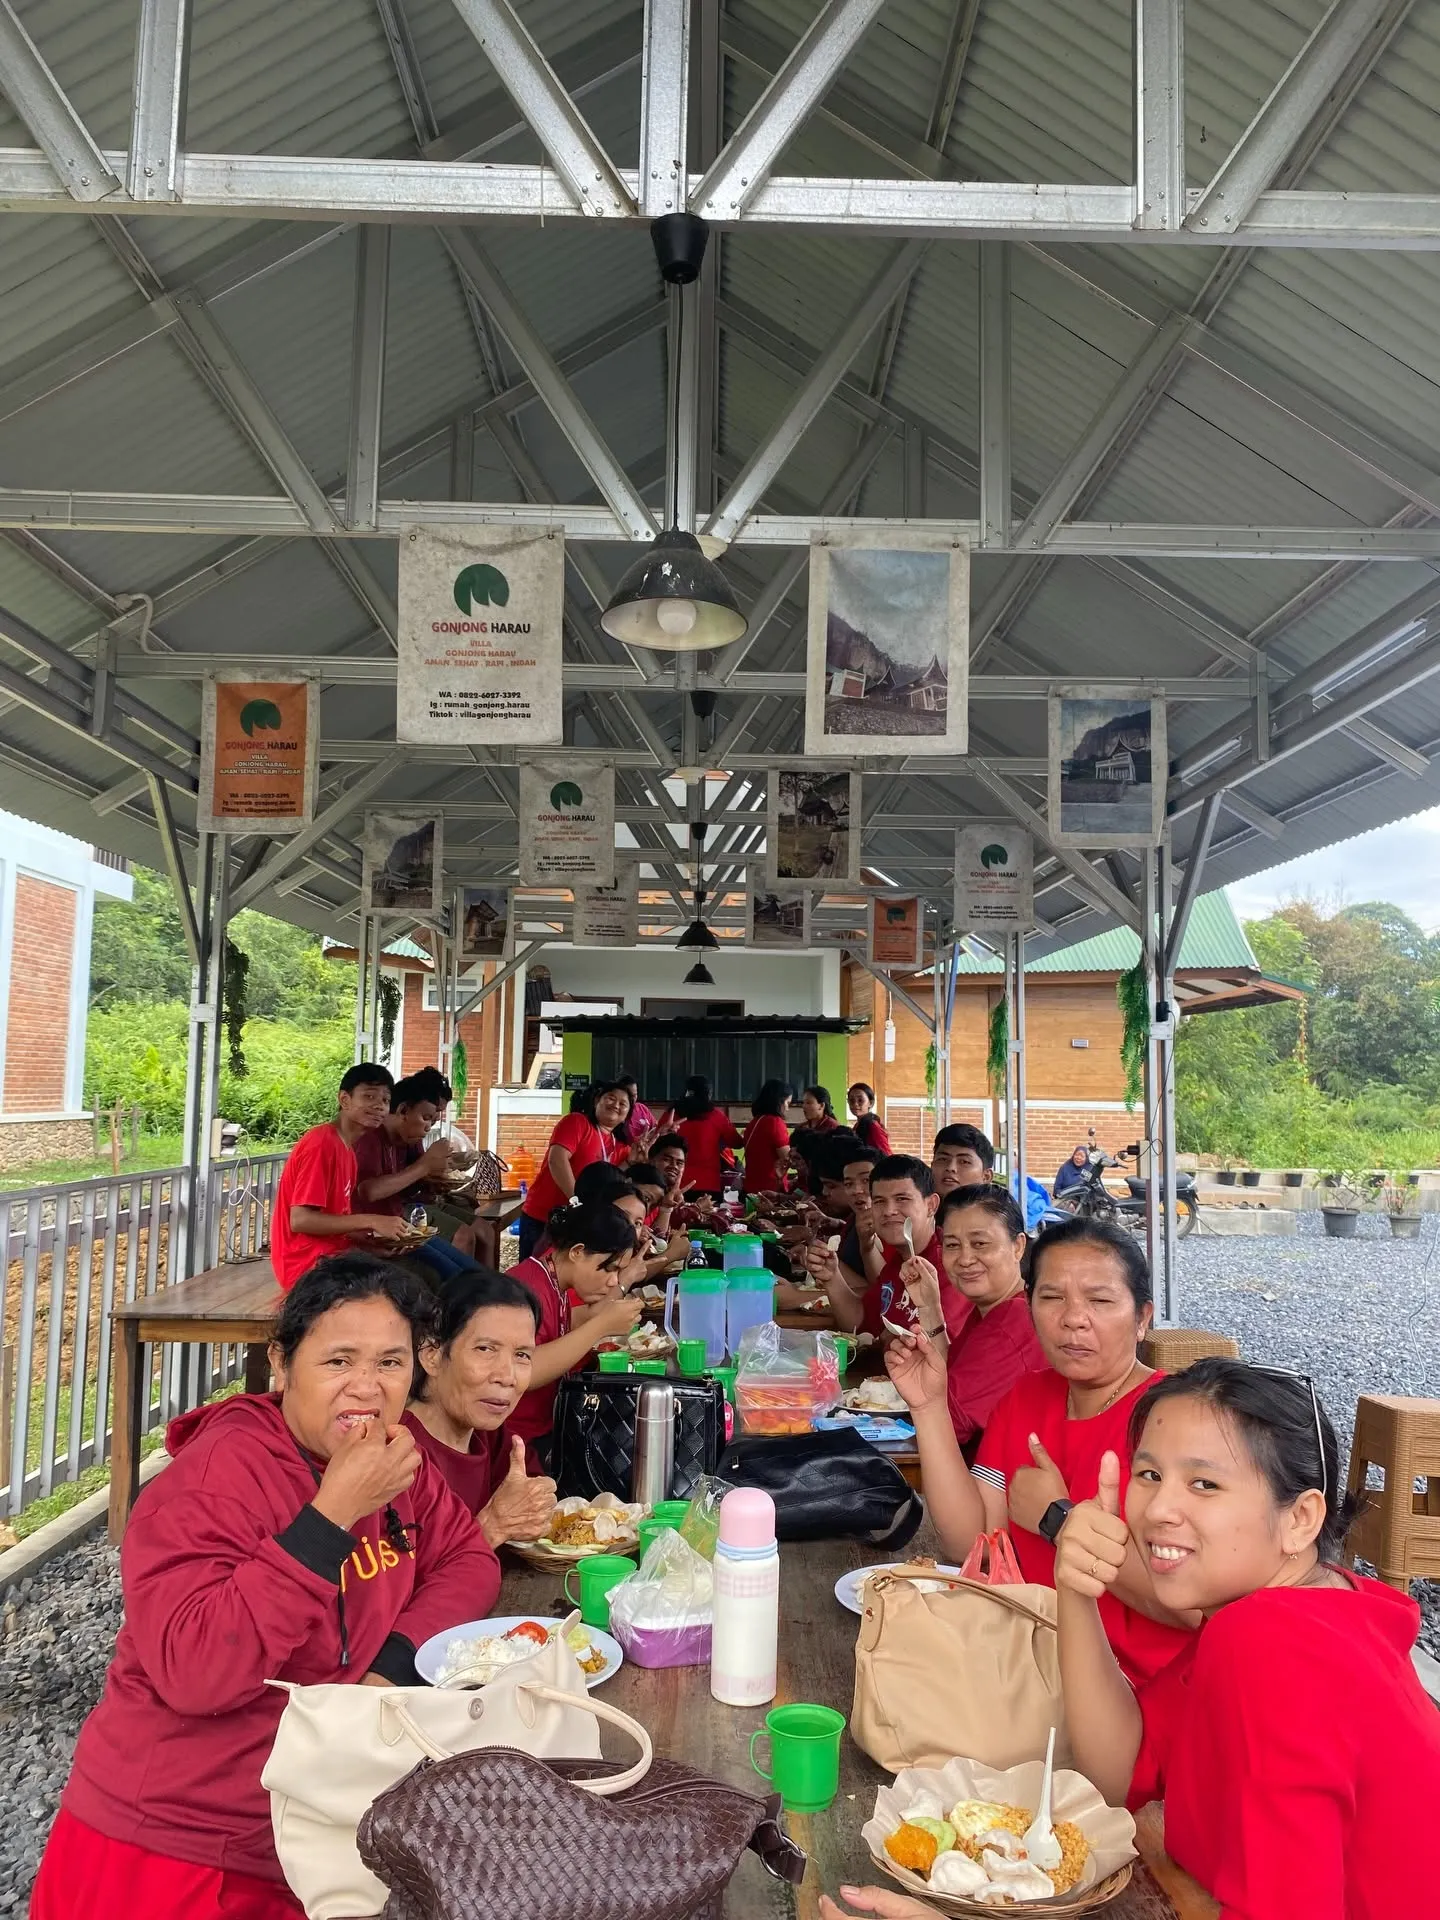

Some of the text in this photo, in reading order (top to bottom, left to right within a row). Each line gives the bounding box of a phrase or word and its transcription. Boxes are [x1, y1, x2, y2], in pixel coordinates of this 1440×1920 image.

[431, 621, 531, 635] GONJONG HARAU
[470, 640, 492, 648] VILLA
[488, 650, 516, 658] HARAU
[267, 742, 298, 750] HARAU
[537, 814, 596, 823] GONJONG HARAU
